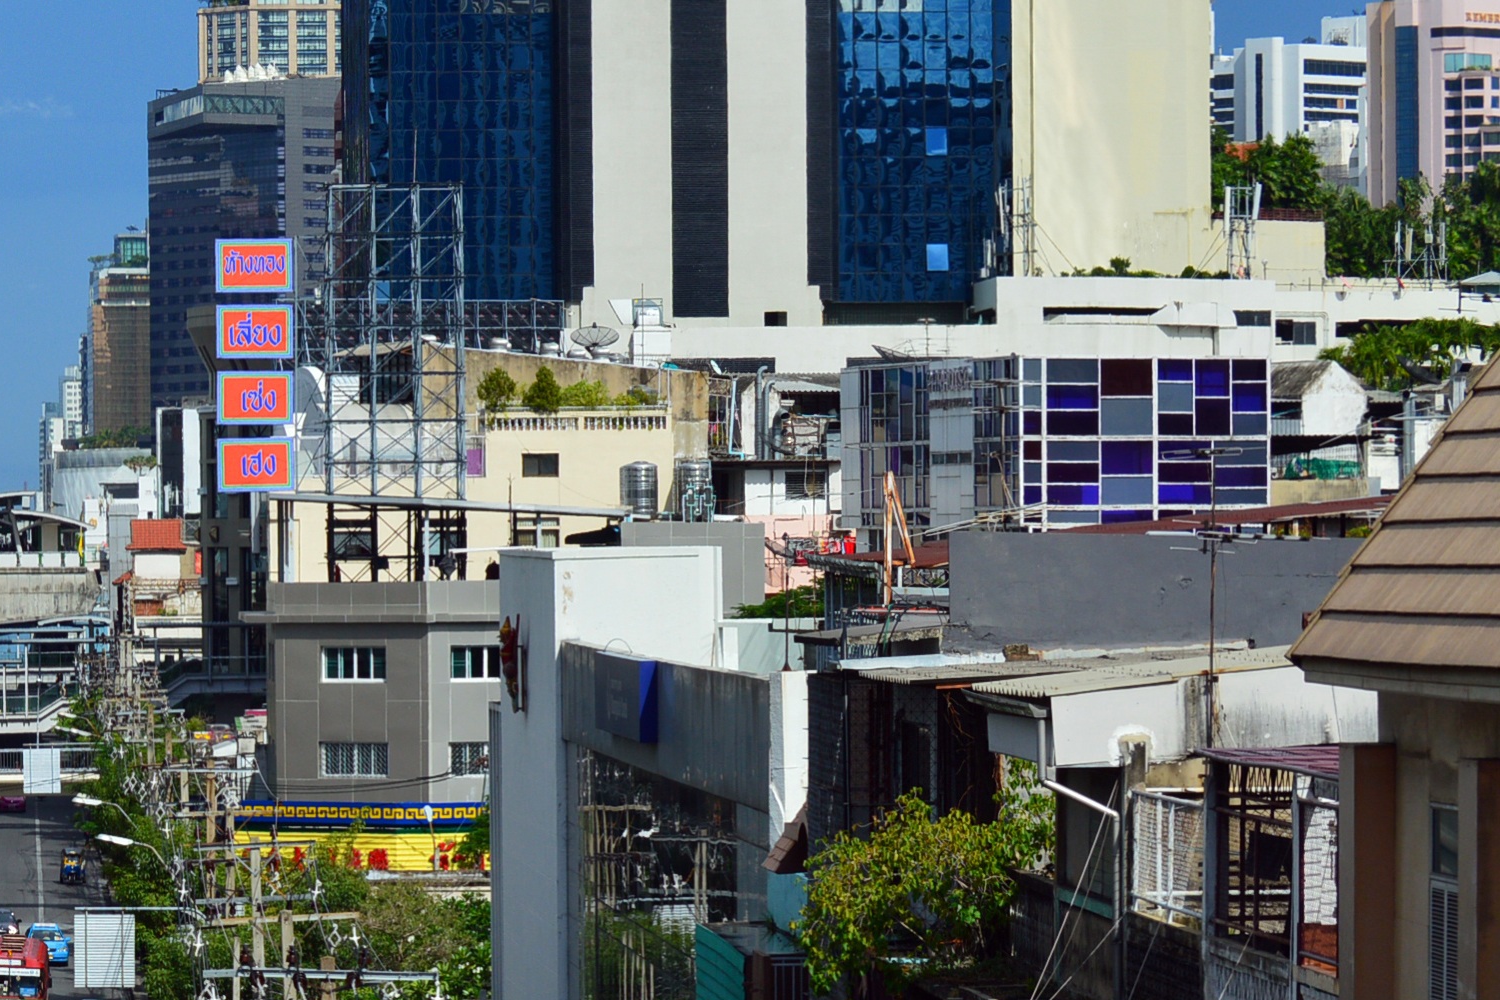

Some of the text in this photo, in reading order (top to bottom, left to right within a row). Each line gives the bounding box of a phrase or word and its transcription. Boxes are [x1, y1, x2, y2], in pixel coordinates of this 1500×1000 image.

[224, 250, 286, 275] ห้างทอง
[241, 380, 277, 412] เซ่ง
[241, 449, 277, 476] เฮง
